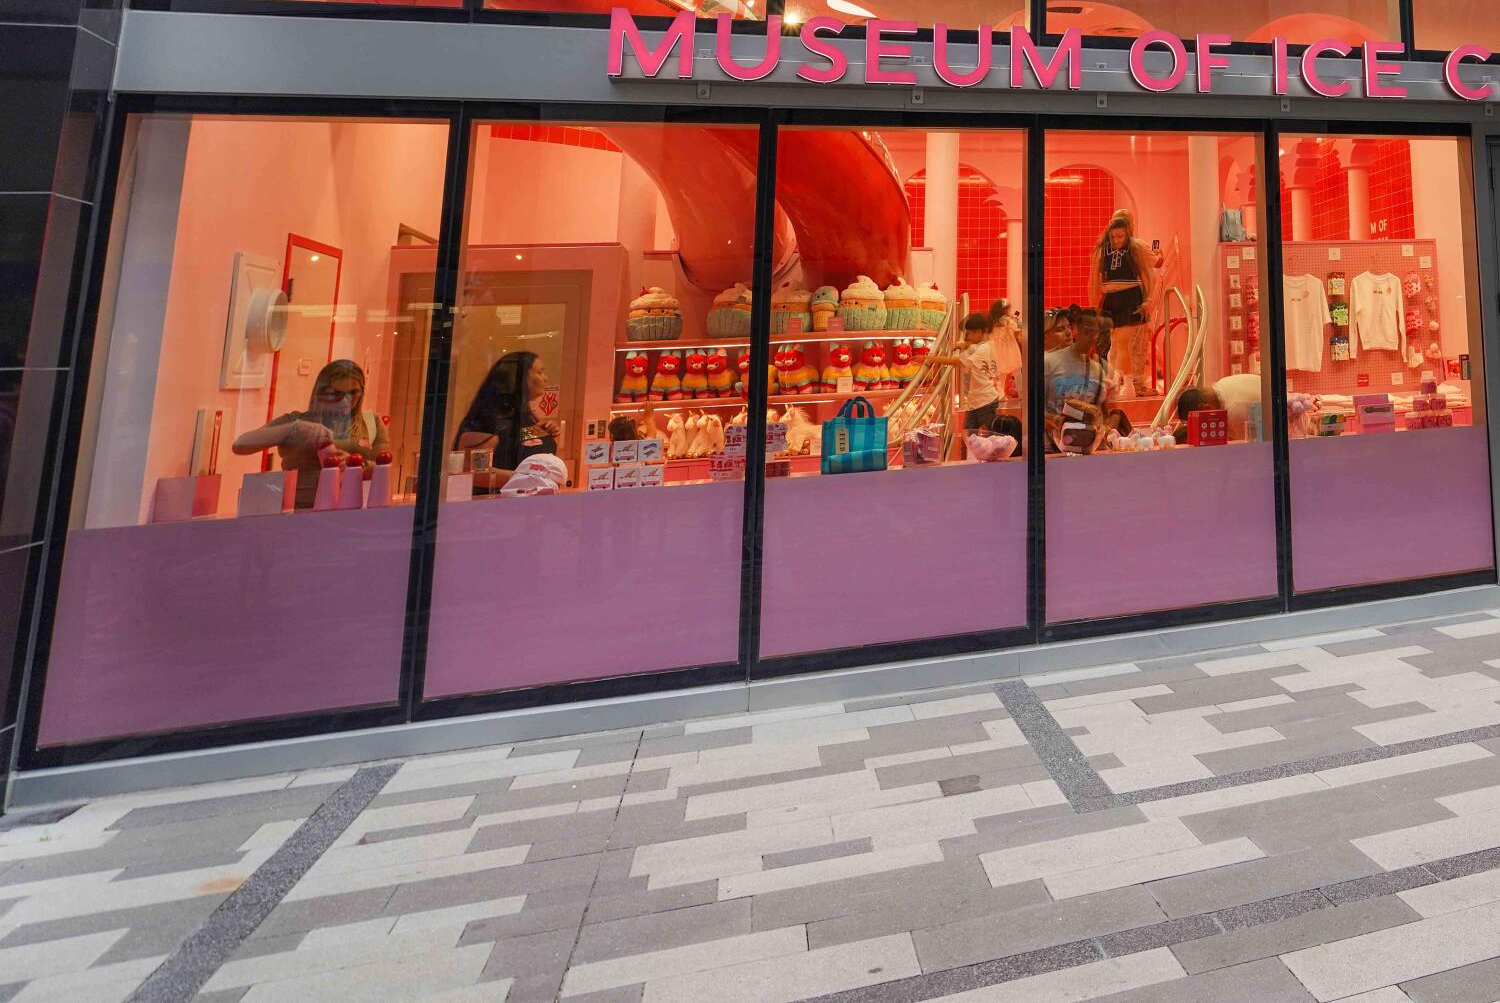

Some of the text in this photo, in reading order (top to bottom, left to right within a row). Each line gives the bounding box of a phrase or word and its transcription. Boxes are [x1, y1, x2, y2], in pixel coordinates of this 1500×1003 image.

[608, 8, 1082, 90] MUSEUM
[1129, 30, 1232, 93] OF
[1273, 36, 1407, 98] ICE
